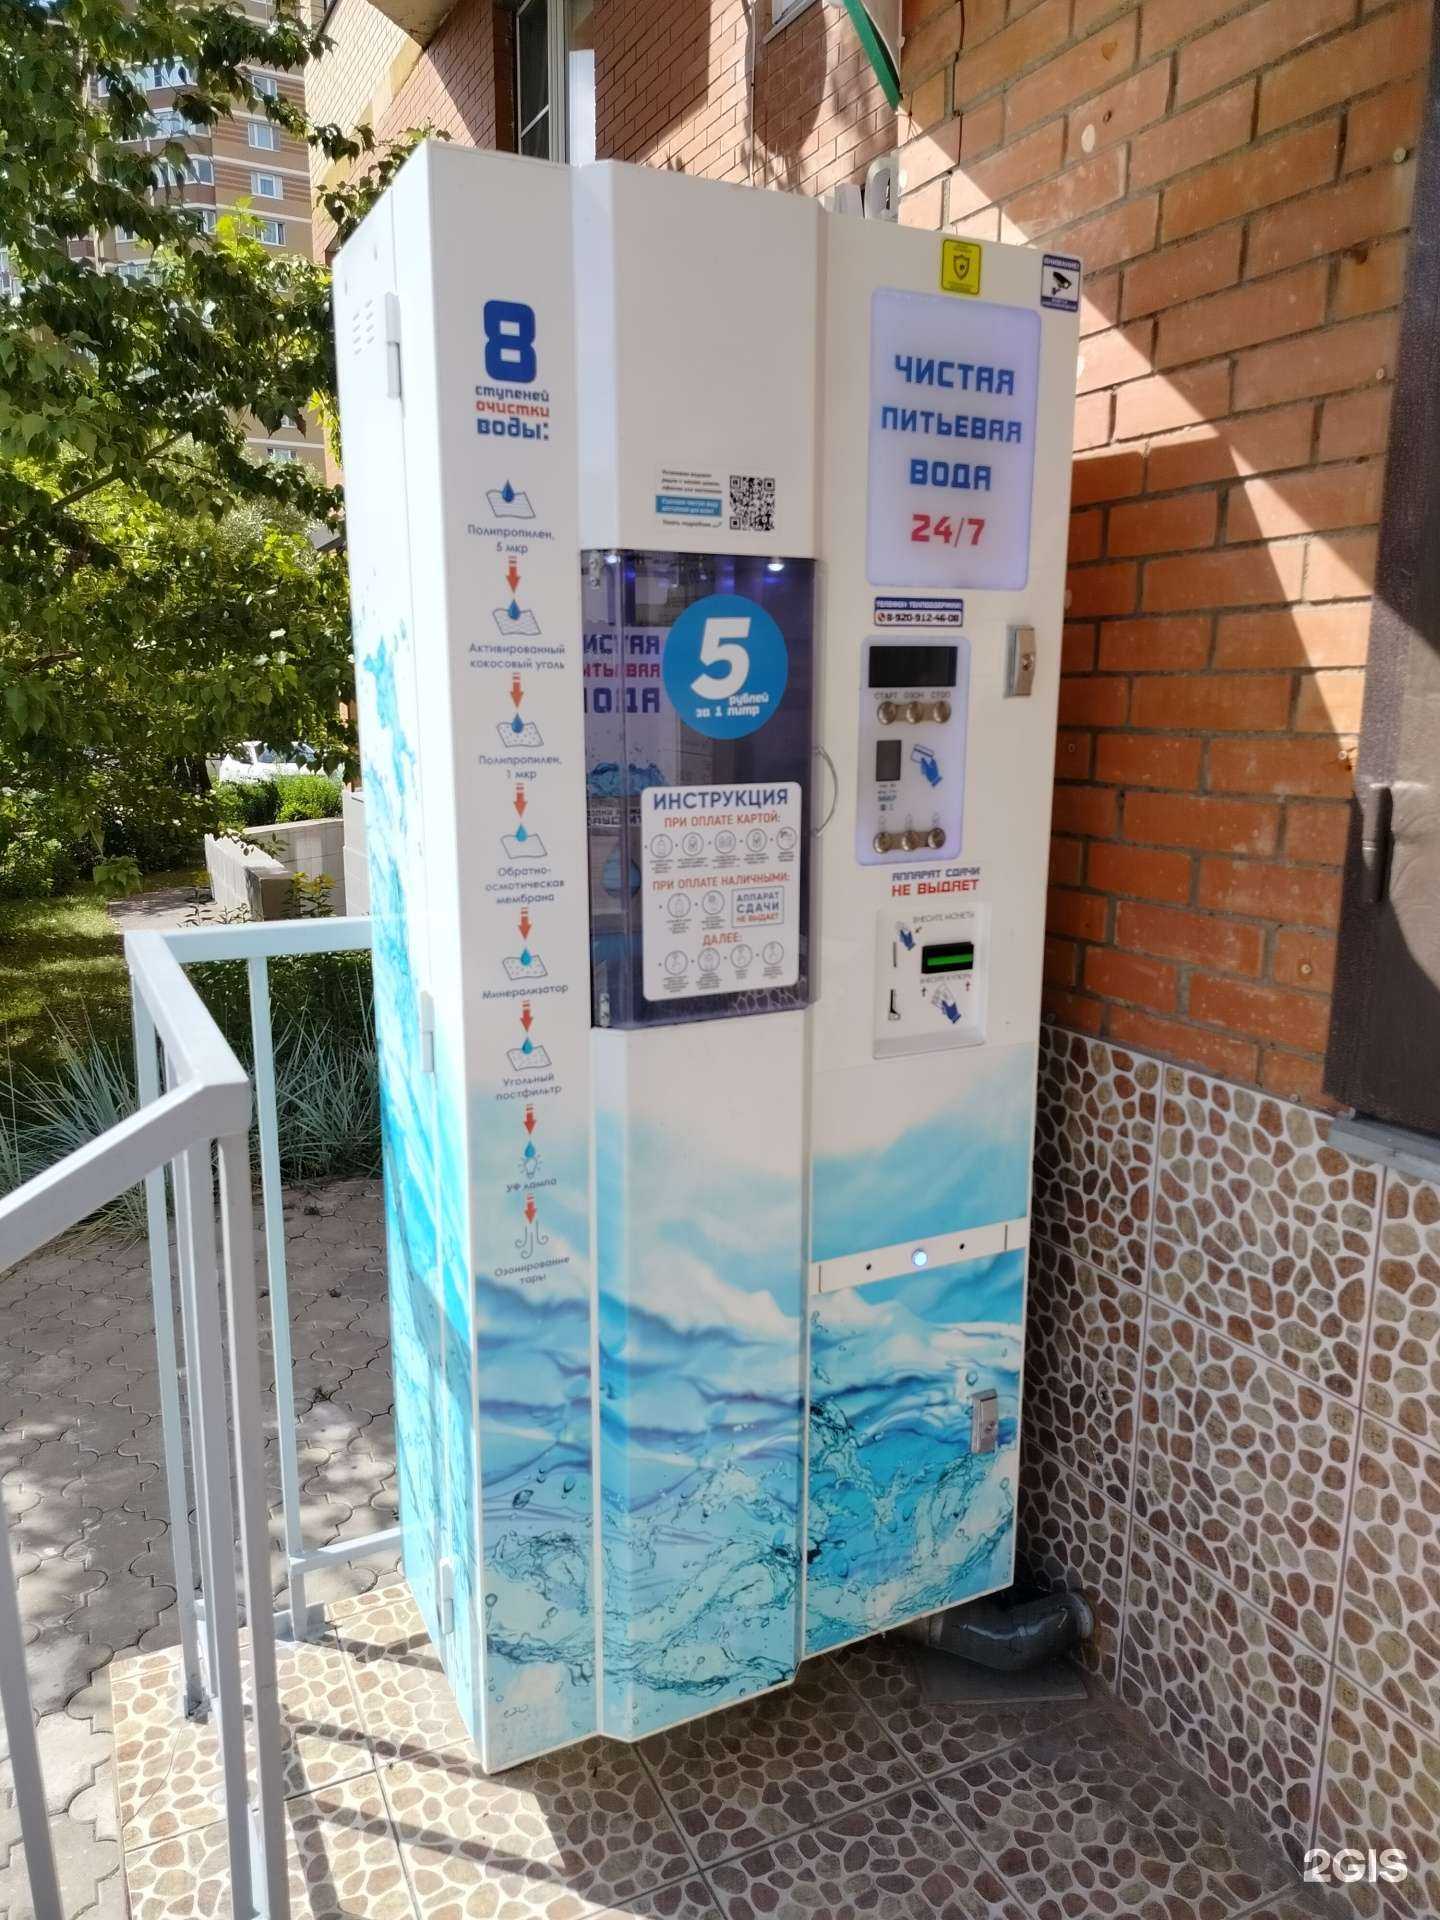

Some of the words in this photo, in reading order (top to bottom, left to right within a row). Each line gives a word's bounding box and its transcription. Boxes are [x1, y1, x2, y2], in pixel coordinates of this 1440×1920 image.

[483, 299, 537, 383] 8
[894, 354, 1015, 395] ЧИСТАЯ
[475, 385, 550, 402] ступеней
[475, 400, 550, 417] очистки
[476, 417, 549, 440] воды:
[880, 406, 1022, 443] ПИТЬЕВАЯ
[909, 458, 992, 491] ВОДА
[910, 513, 986, 548] 24/7
[496, 542, 503, 552] 5
[505, 544, 529, 555] мкр
[469, 643, 566, 655] Активированный
[470, 659, 532, 669] кокосовый
[536, 661, 565, 671] уголь
[690, 616, 752, 700] 5
[729, 691, 769, 706] рублей
[696, 708, 711, 718] за
[715, 705, 722, 717] 1
[727, 704, 760, 717] литр
[478, 756, 562, 767] Полипропилен,
[514, 771, 537, 780] мкр
[653, 788, 789, 811] ИНСТРУКЦИЯ
[664, 816, 688, 828] ПРИ
[691, 814, 734, 827] ОПЛАТЕ
[736, 810, 781, 825] КАРТОЙ:
[498, 866, 551, 877] Обратно-
[891, 869, 942, 882] АППАРАТ
[945, 867, 981, 877] СДАЧИ
[485, 879, 565, 892] осмотическая
[653, 880, 674, 890] ПРИ
[678, 876, 718, 889] ОПЛАТЕ
[720, 871, 790, 886] НАЛИЧНЫМИ:
[891, 884, 911, 897] НЕ
[917, 879, 980, 895] ВЫДАЕТ
[496, 893, 555, 904] мембрана
[736, 891, 780, 902] АППАРАТ
[736, 902, 780, 914] СДАЧИ
[702, 931, 743, 946] ДАЛЕЕ:
[482, 984, 569, 999] Минерализатор
[503, 1073, 554, 1087] Угольный
[496, 1085, 562, 1101] постфильтр
[494, 1256, 570, 1277] Озонирование
